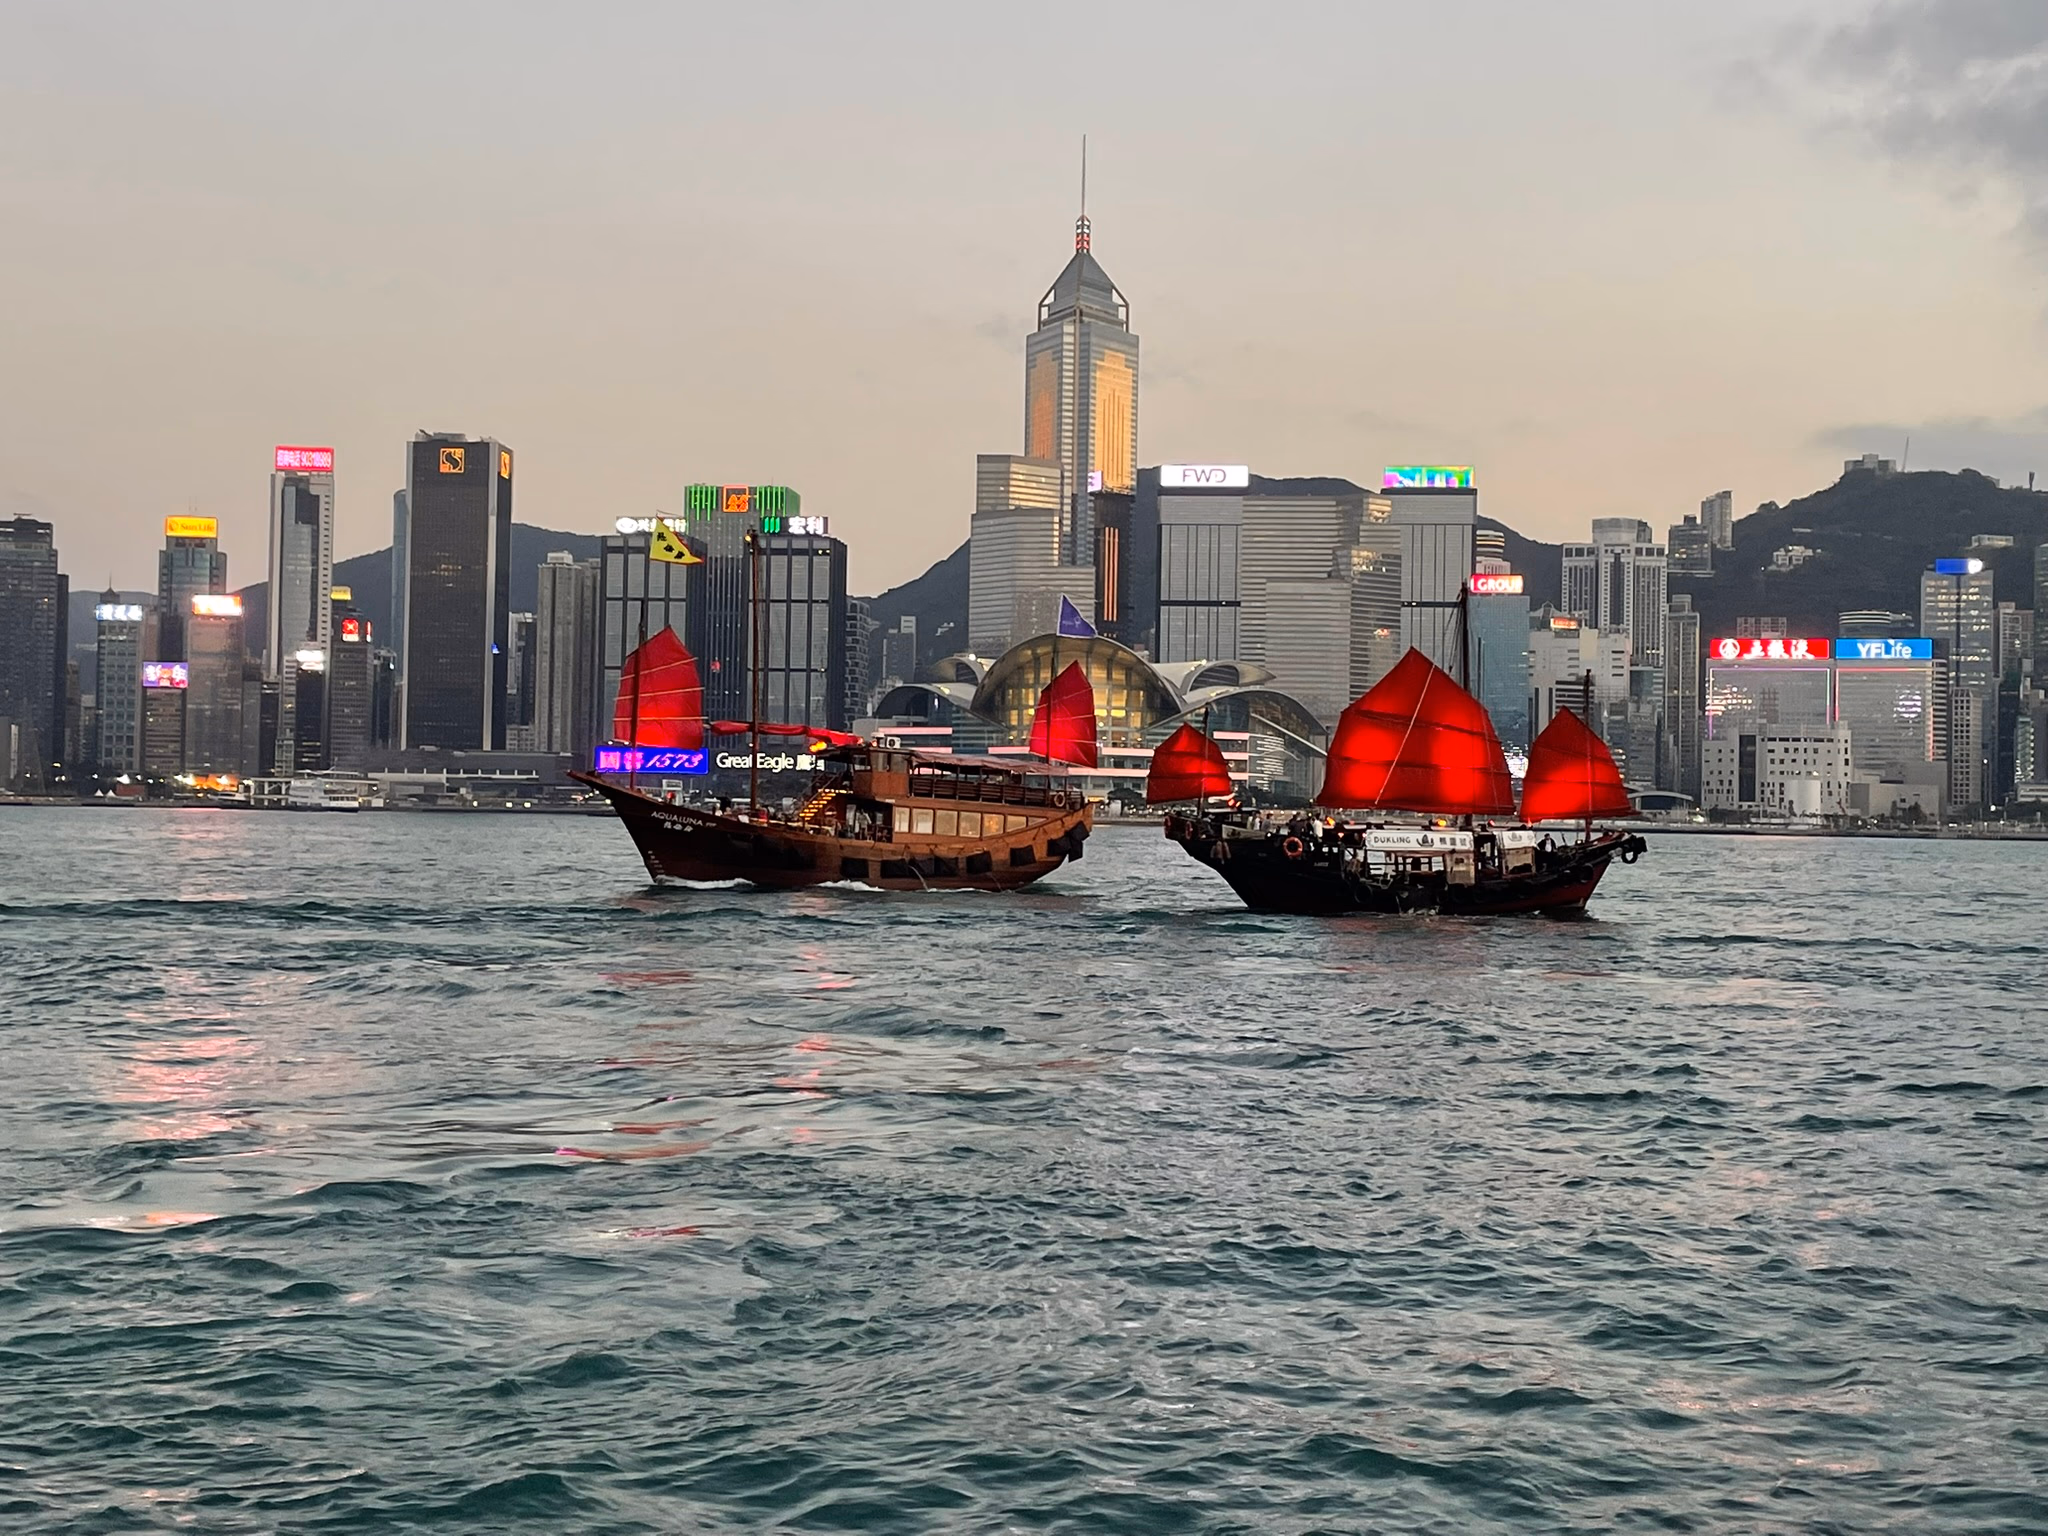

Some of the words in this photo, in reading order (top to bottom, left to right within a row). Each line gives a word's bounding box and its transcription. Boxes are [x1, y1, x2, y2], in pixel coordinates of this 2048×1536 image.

[1182, 468, 1227, 483] FWD
[788, 516, 824, 534] 宏利
[716, 752, 753, 768] Great
[756, 752, 794, 773] Eagle
[651, 811, 704, 826] AQUALUNA
[1374, 836, 1411, 844] DUKLING
